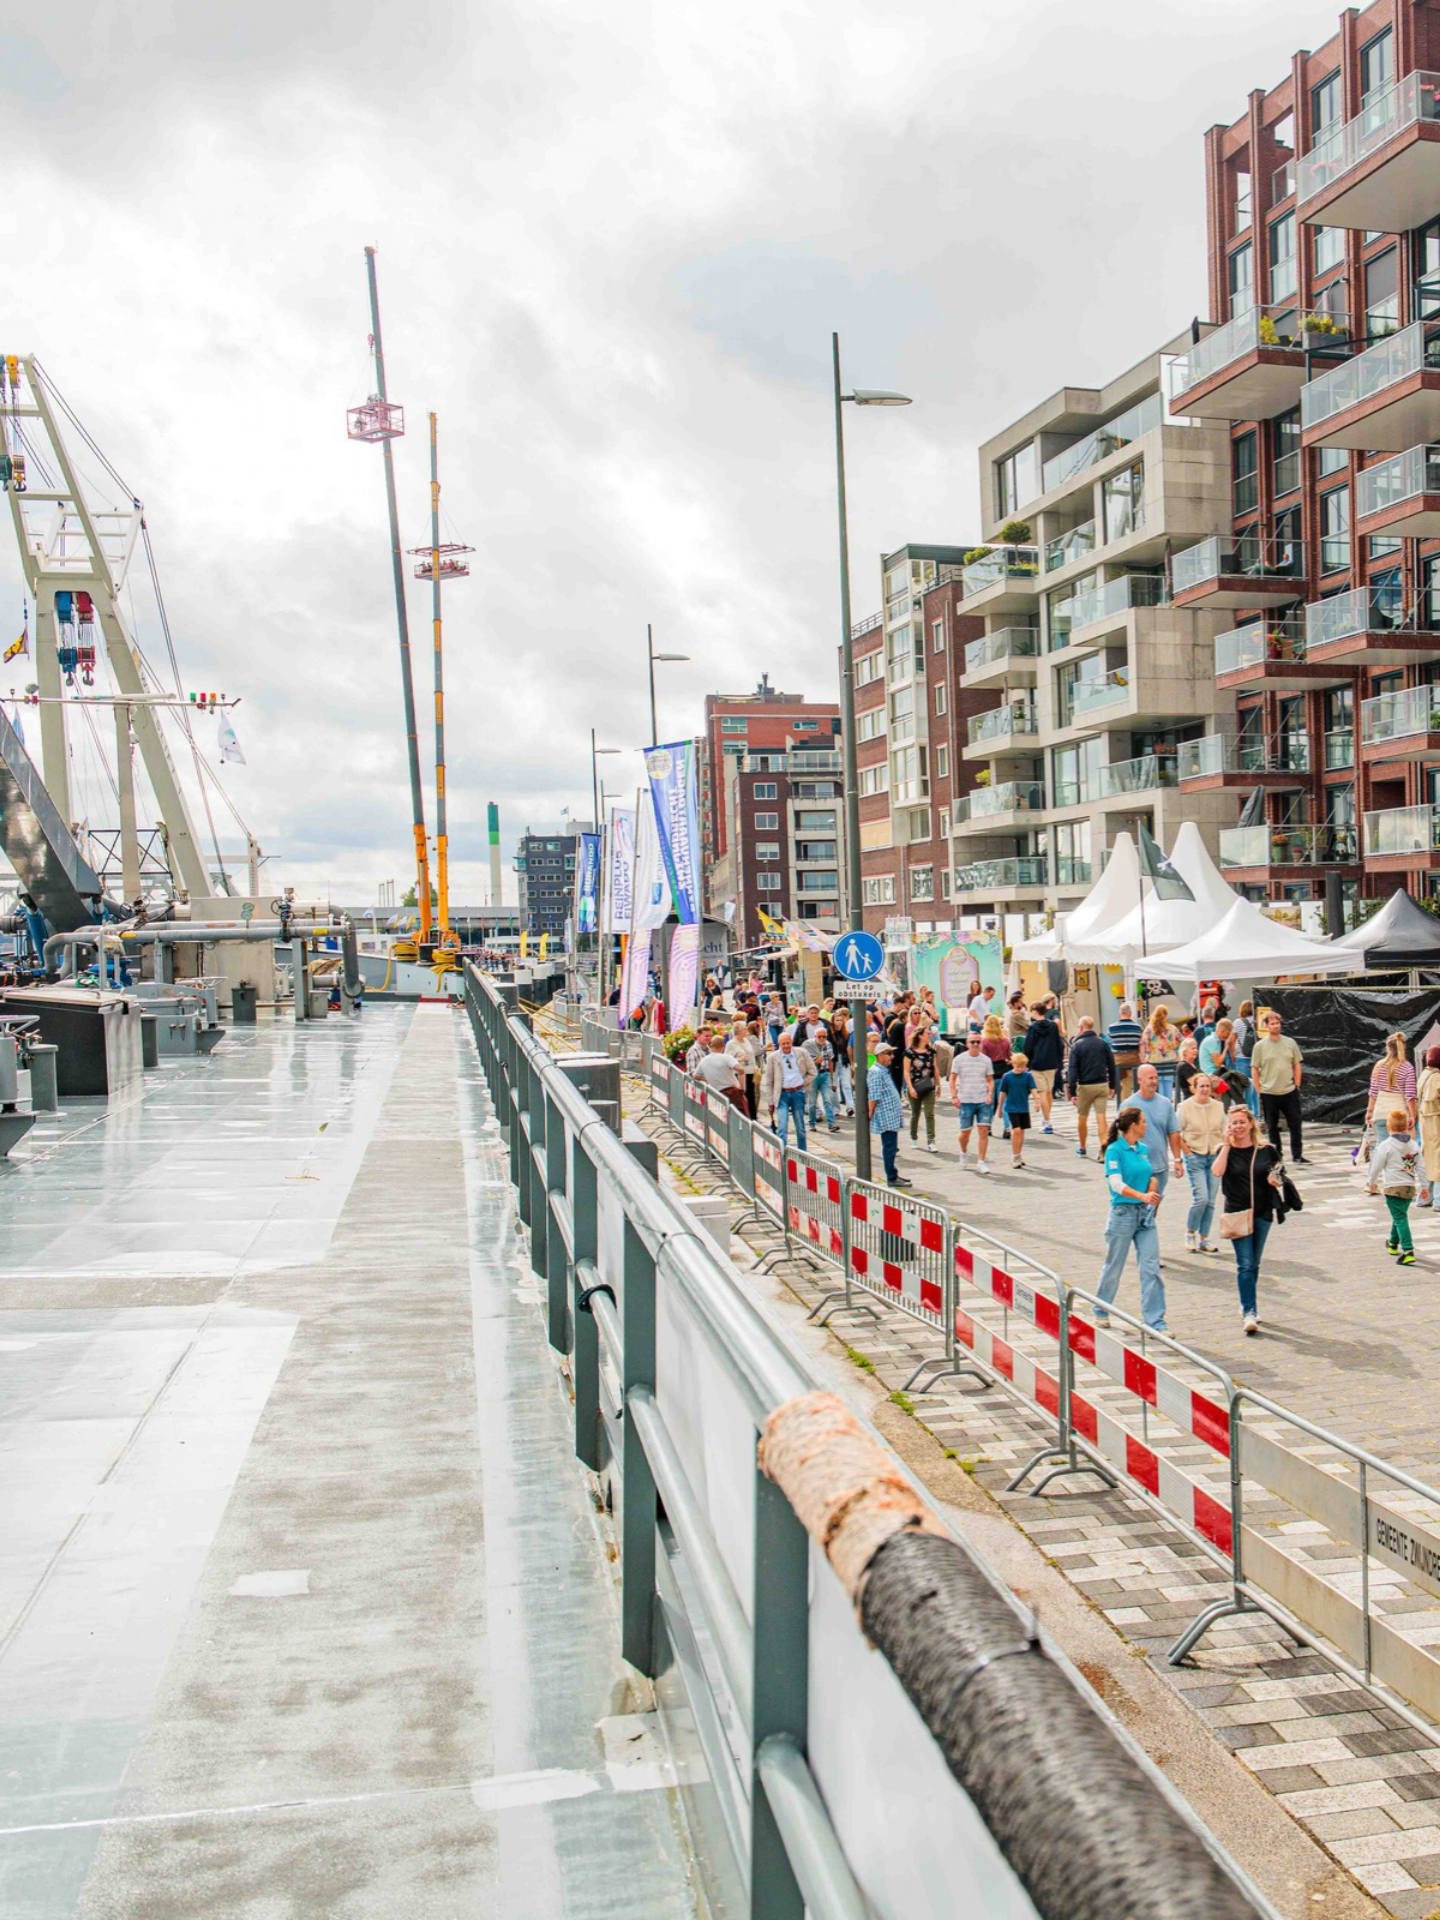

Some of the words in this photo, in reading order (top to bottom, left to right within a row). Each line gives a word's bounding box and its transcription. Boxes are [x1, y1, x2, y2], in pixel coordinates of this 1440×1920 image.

[583, 843, 595, 891] BURANDO
[614, 850, 624, 919] REINPLUS
[1376, 1517, 1409, 1561] GEMEENTE
